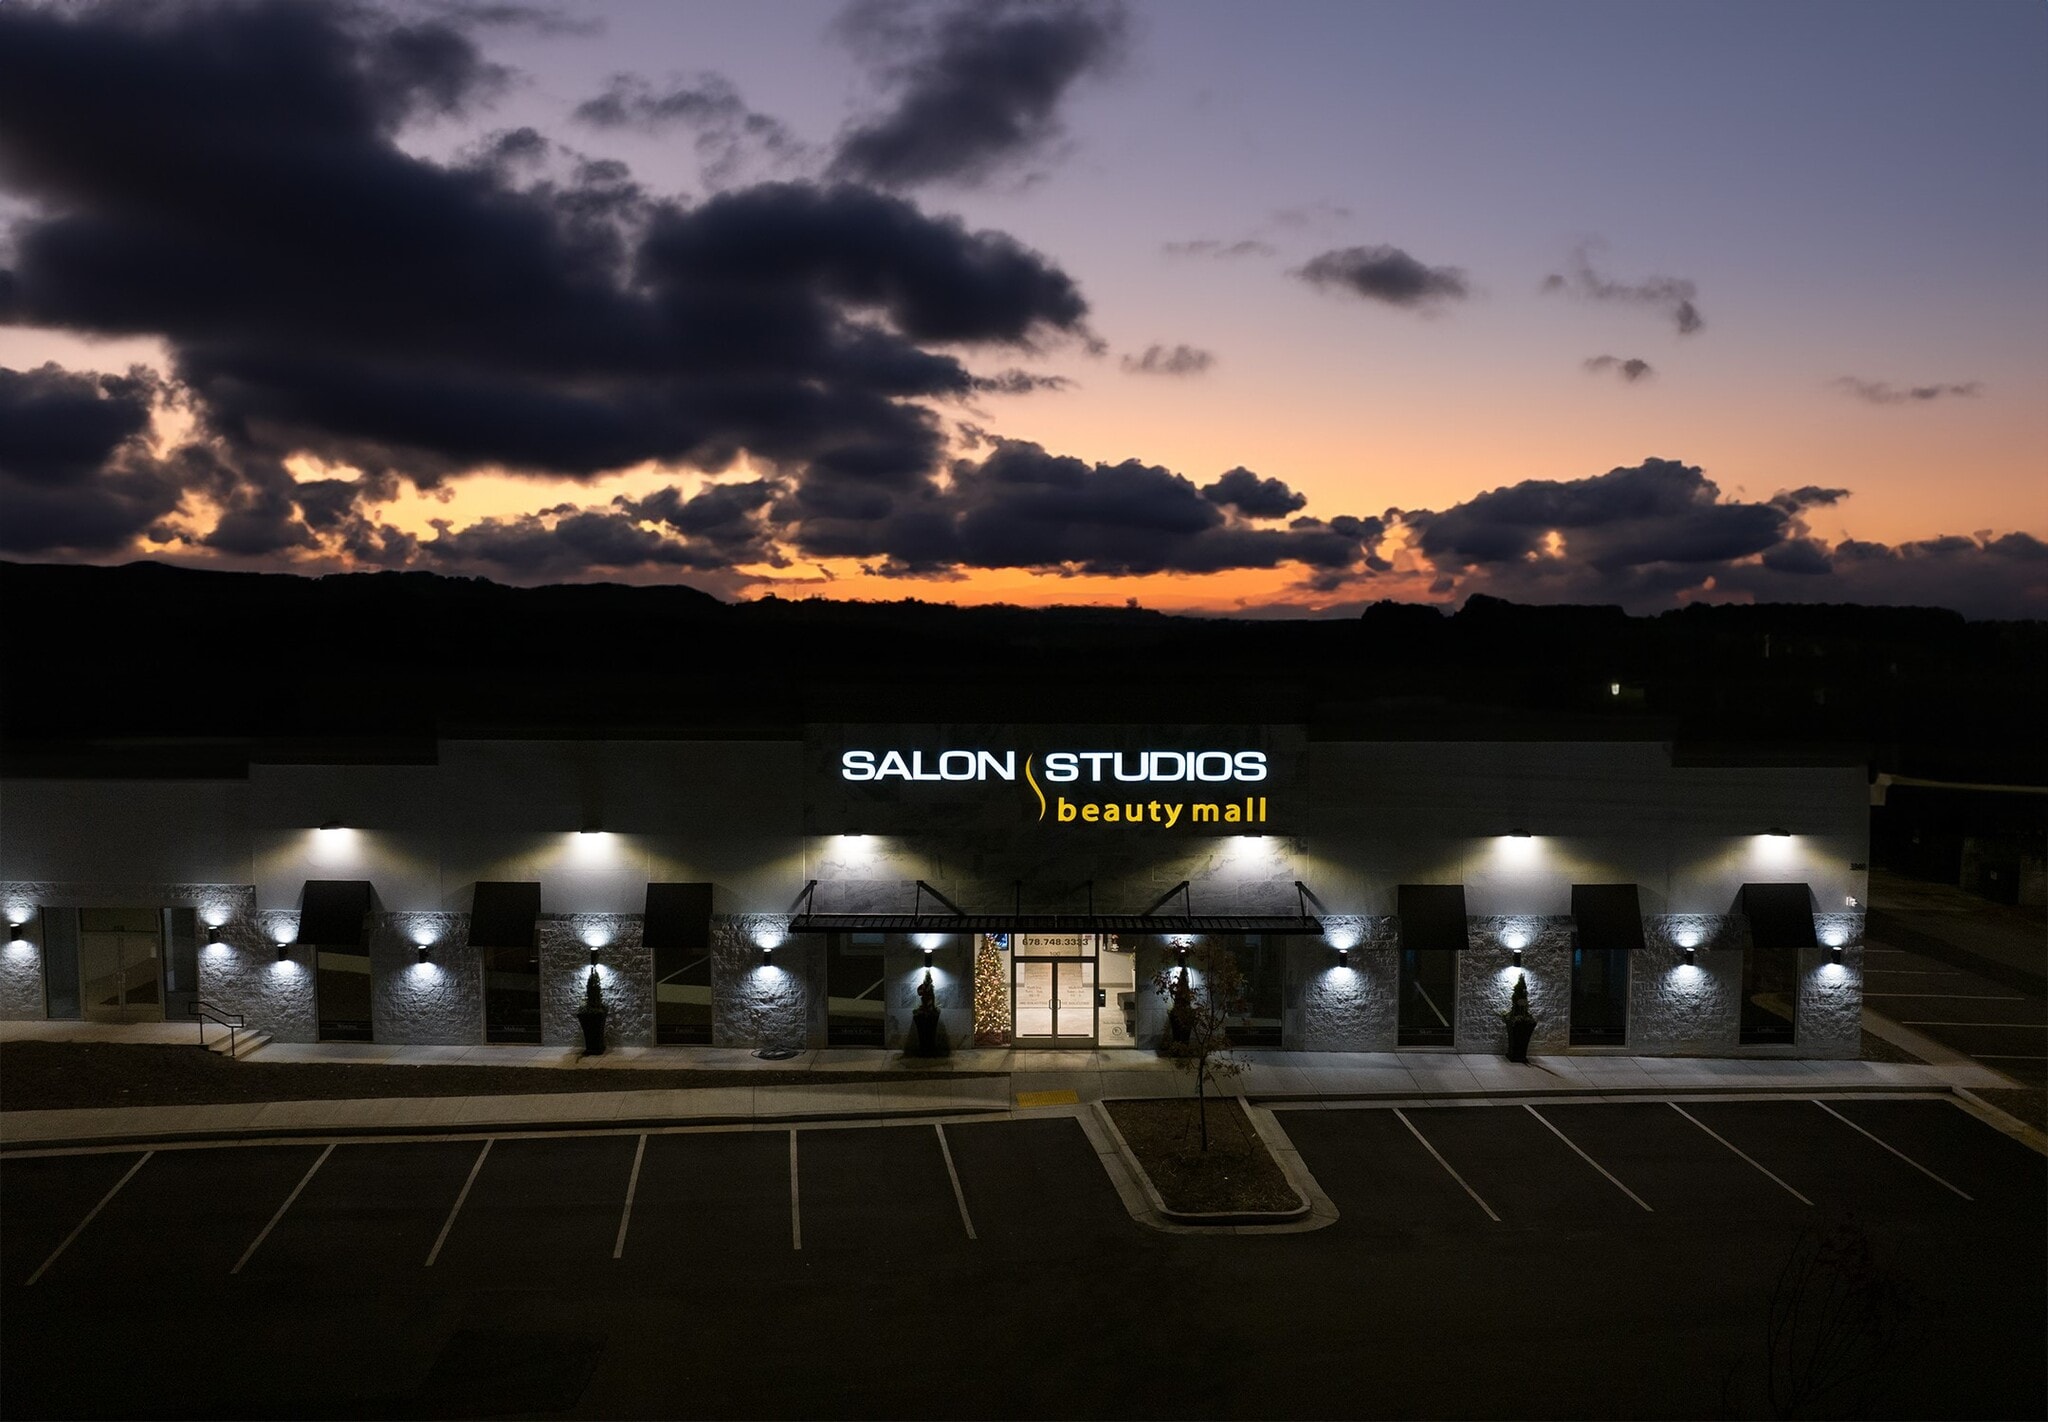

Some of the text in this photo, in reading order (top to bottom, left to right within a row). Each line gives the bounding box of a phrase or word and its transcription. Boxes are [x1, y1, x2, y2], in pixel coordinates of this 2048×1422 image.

[842, 751, 1268, 782] SALON STUDIOS
[1057, 797, 1267, 829] beauty mall
[1022, 938, 1089, 946] 678.748.3333
